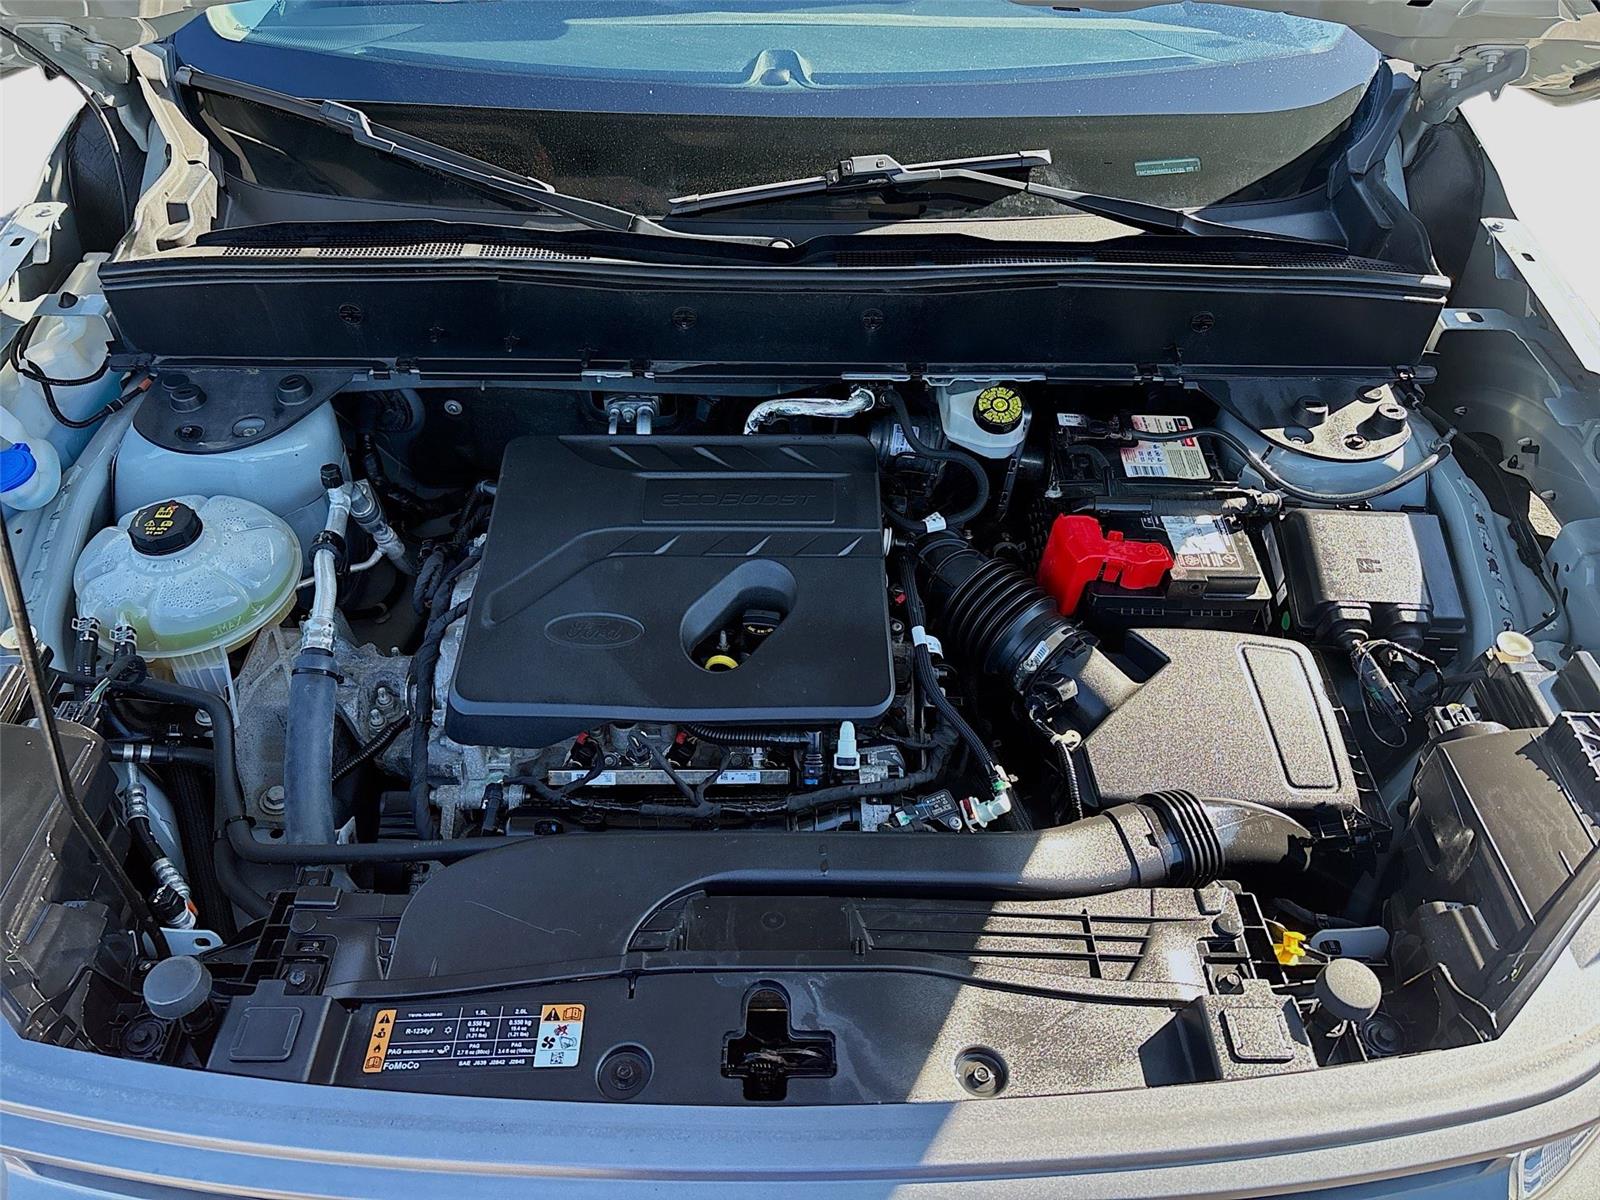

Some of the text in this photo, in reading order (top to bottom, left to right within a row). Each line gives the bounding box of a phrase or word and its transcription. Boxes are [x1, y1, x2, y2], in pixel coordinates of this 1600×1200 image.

[566, 620, 624, 641] Ford
[483, 1020, 491, 1028] kg
[524, 1019, 532, 1027] kg
[405, 1027, 434, 1036] R-1234yf
[383, 1061, 420, 1071] FoMoCo
